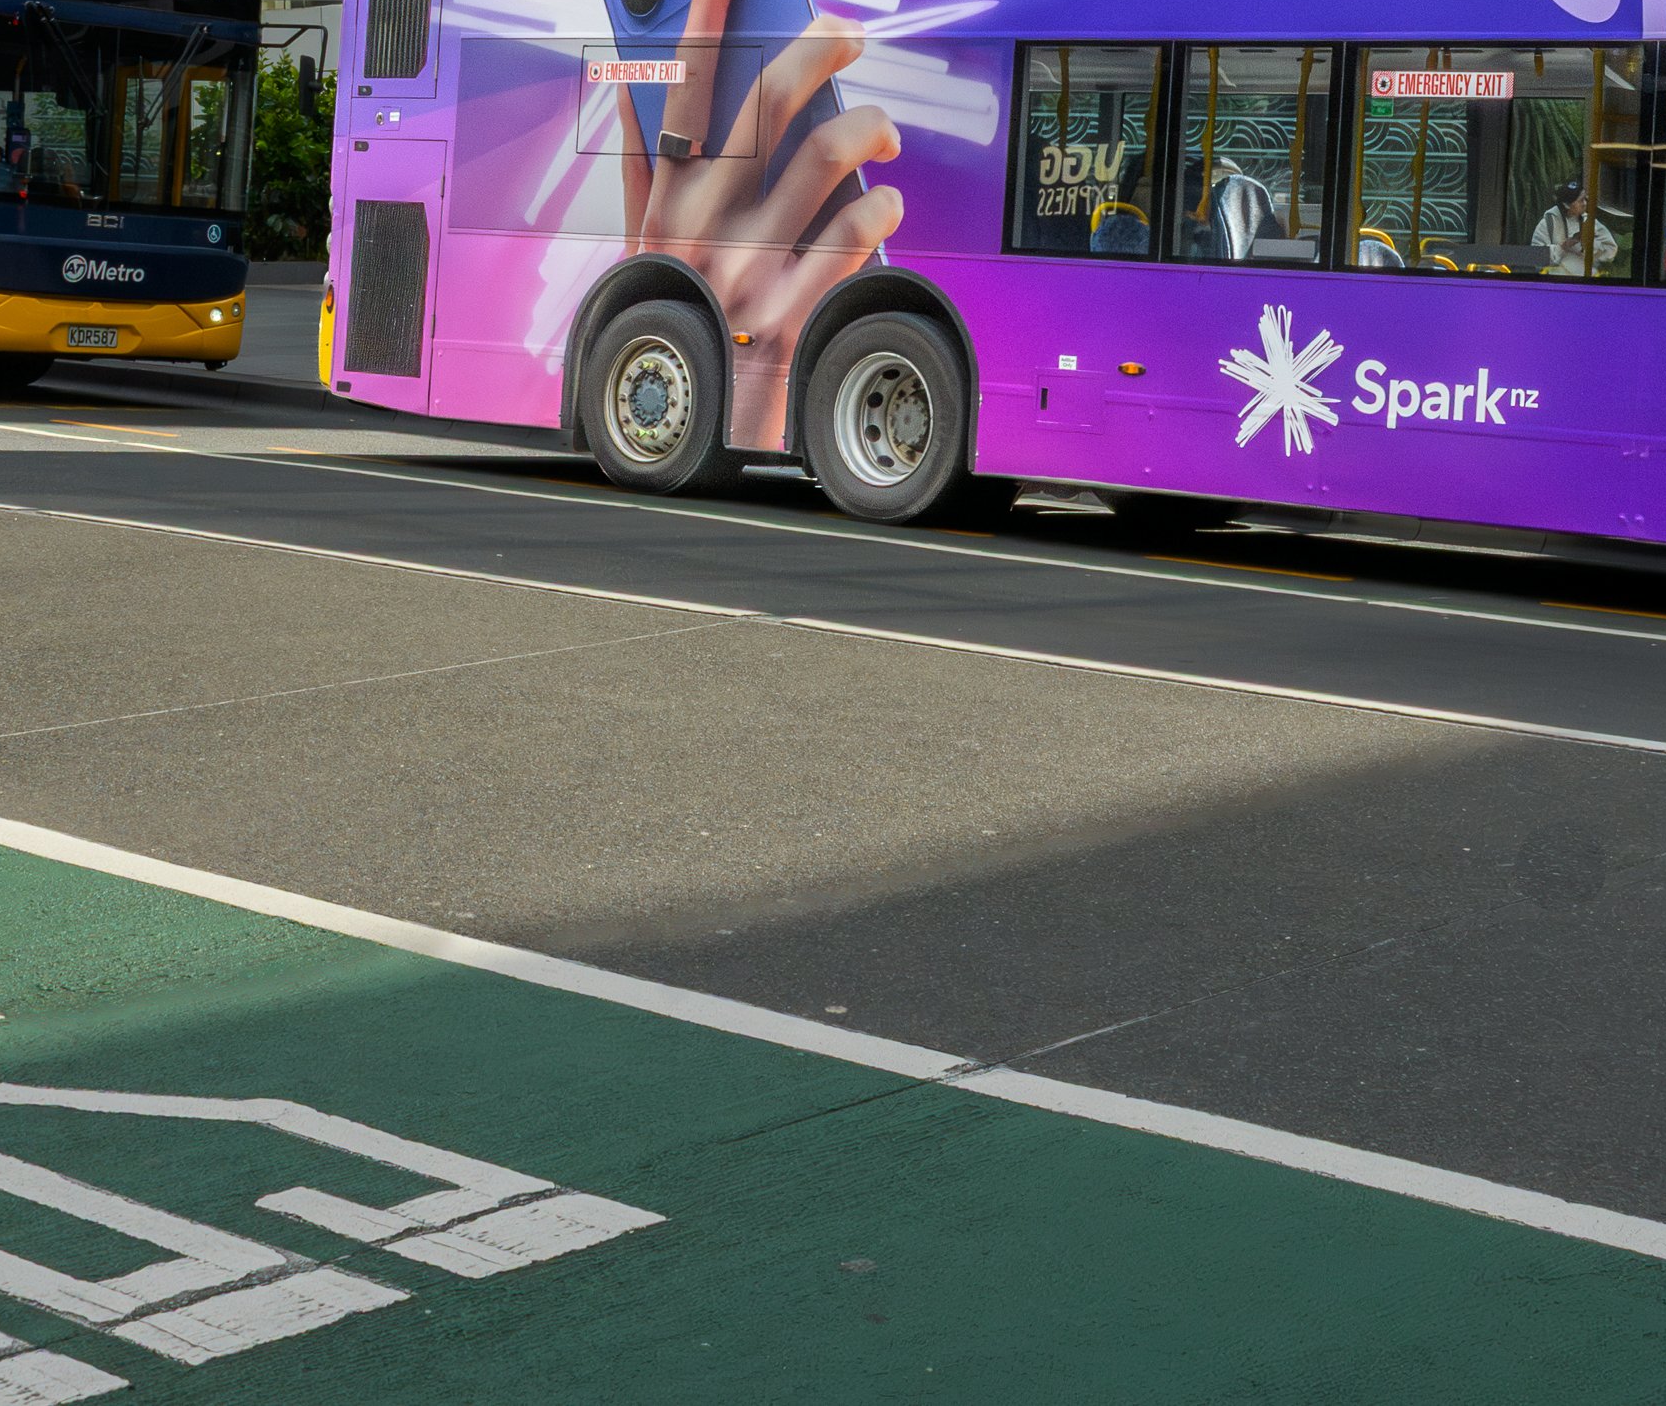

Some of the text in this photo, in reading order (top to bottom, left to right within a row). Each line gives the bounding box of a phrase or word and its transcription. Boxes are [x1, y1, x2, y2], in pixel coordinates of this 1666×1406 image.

[605, 62, 679, 81] EMERGENCY EXIT
[1397, 73, 1504, 96] EMERGENCY EXIT
[87, 260, 145, 283] Metro
[69, 327, 117, 346] KDR587
[1351, 358, 1508, 429] Spark
